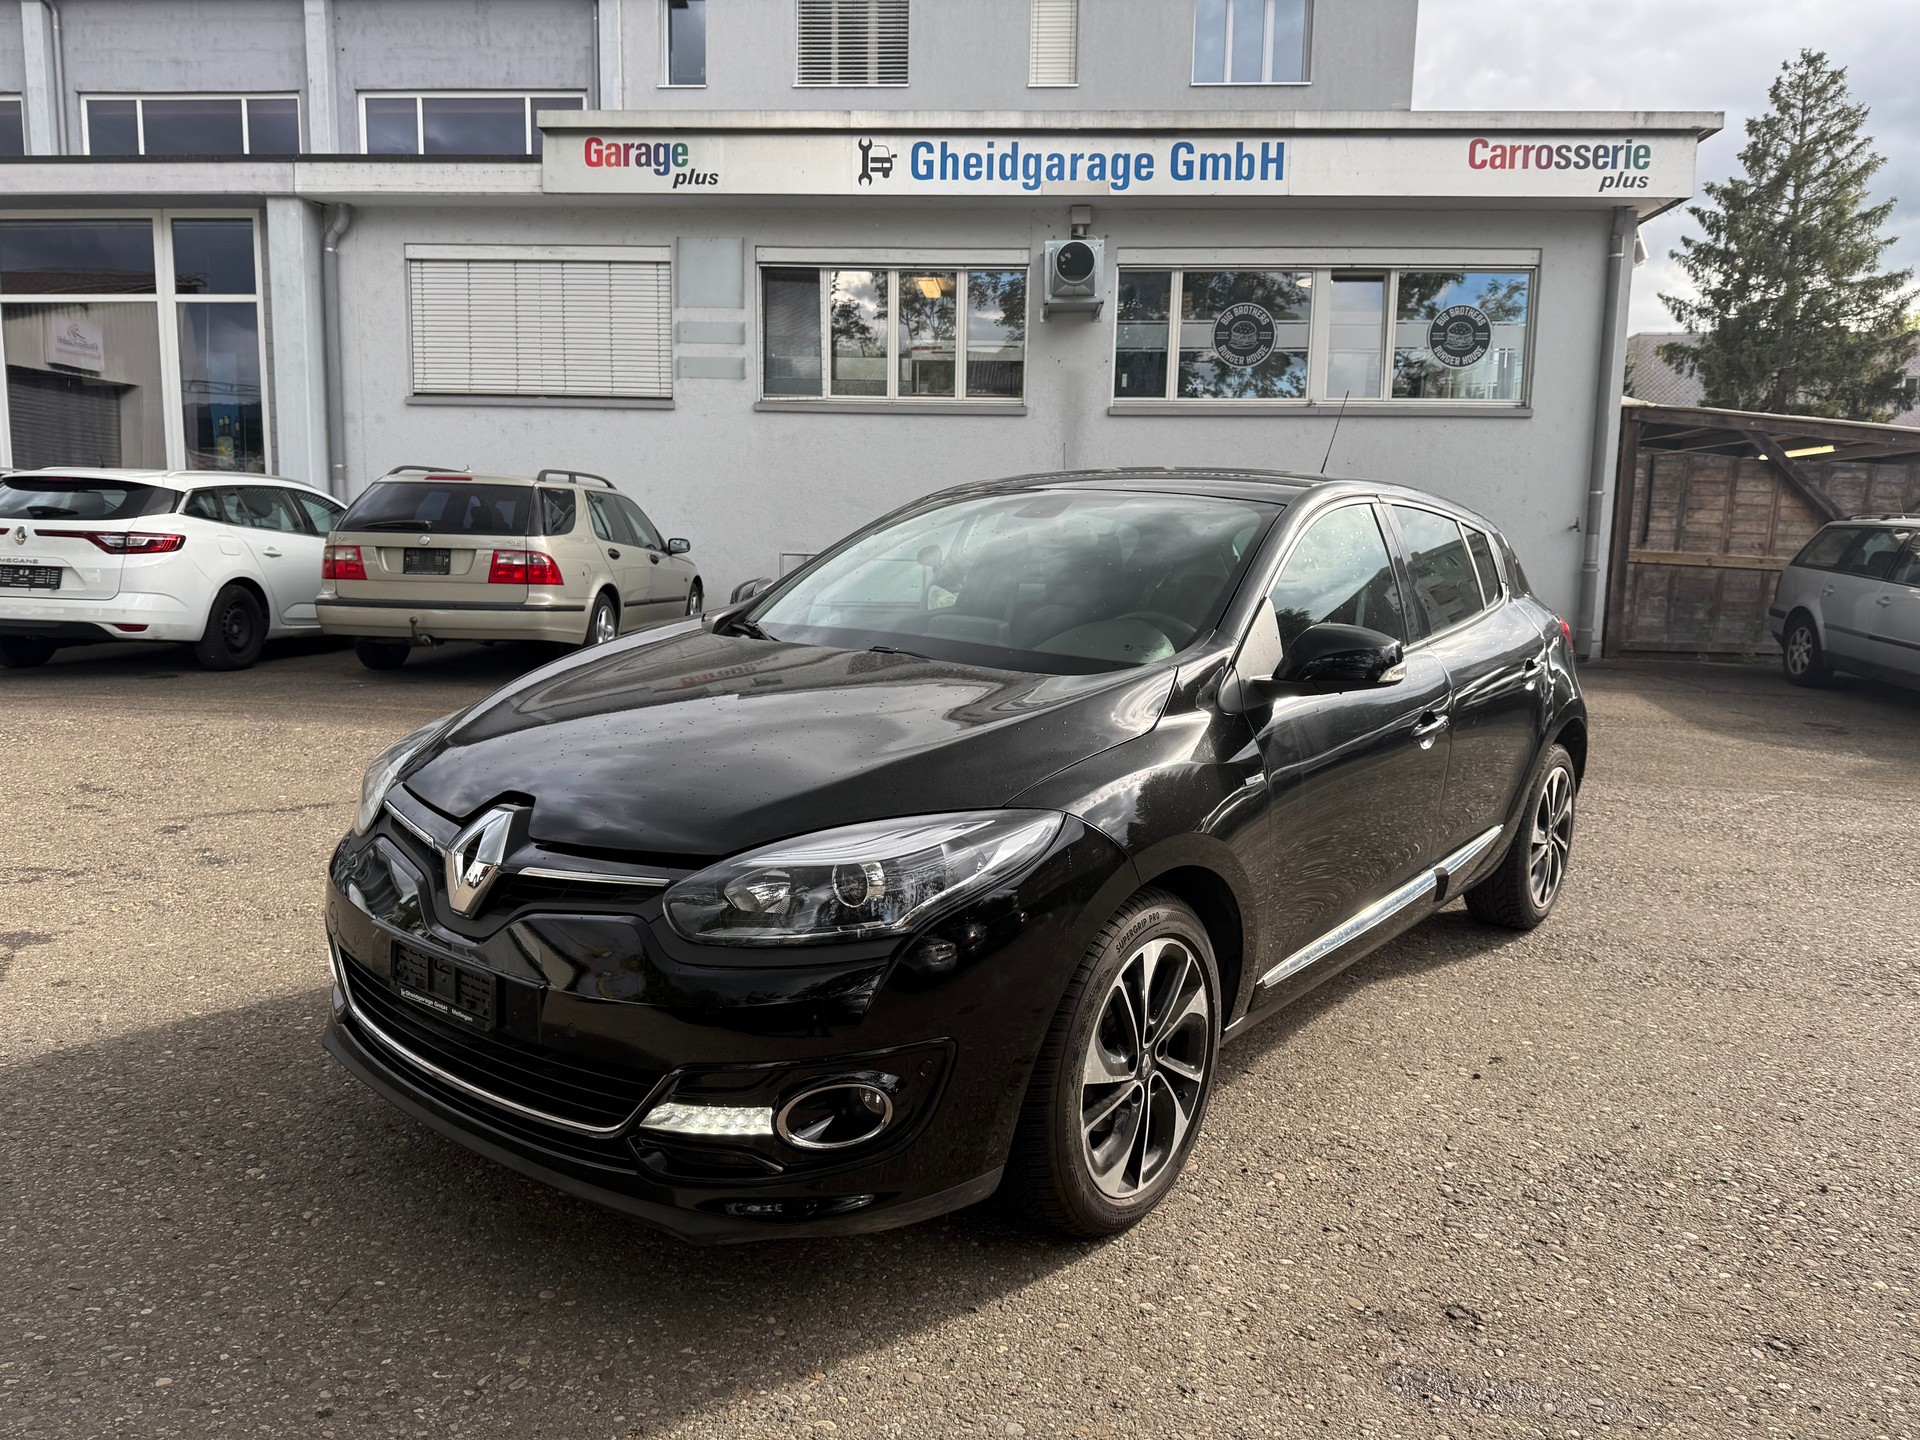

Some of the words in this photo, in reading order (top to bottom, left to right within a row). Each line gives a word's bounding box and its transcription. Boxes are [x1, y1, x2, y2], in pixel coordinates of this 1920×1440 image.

[584, 136, 689, 176] Garage
[1468, 138, 1651, 170] Carrosserie
[910, 141, 1155, 190] Gheidgarage
[1170, 141, 1285, 181] GmbH
[672, 168, 719, 189] plus
[1598, 171, 1650, 192] plus
[1220, 311, 1234, 326] BIG
[1233, 305, 1270, 326] BROTHERS
[1436, 312, 1450, 327] BIG
[1448, 306, 1487, 327] BROTHERS
[1218, 344, 1245, 365] BURGER
[1246, 344, 1269, 365] HOUSE
[1433, 345, 1461, 366] BURGER
[1461, 345, 1486, 365] HOUSE
[1115, 917, 1148, 954] SUPERGRIP
[1148, 911, 1160, 923] PRO
